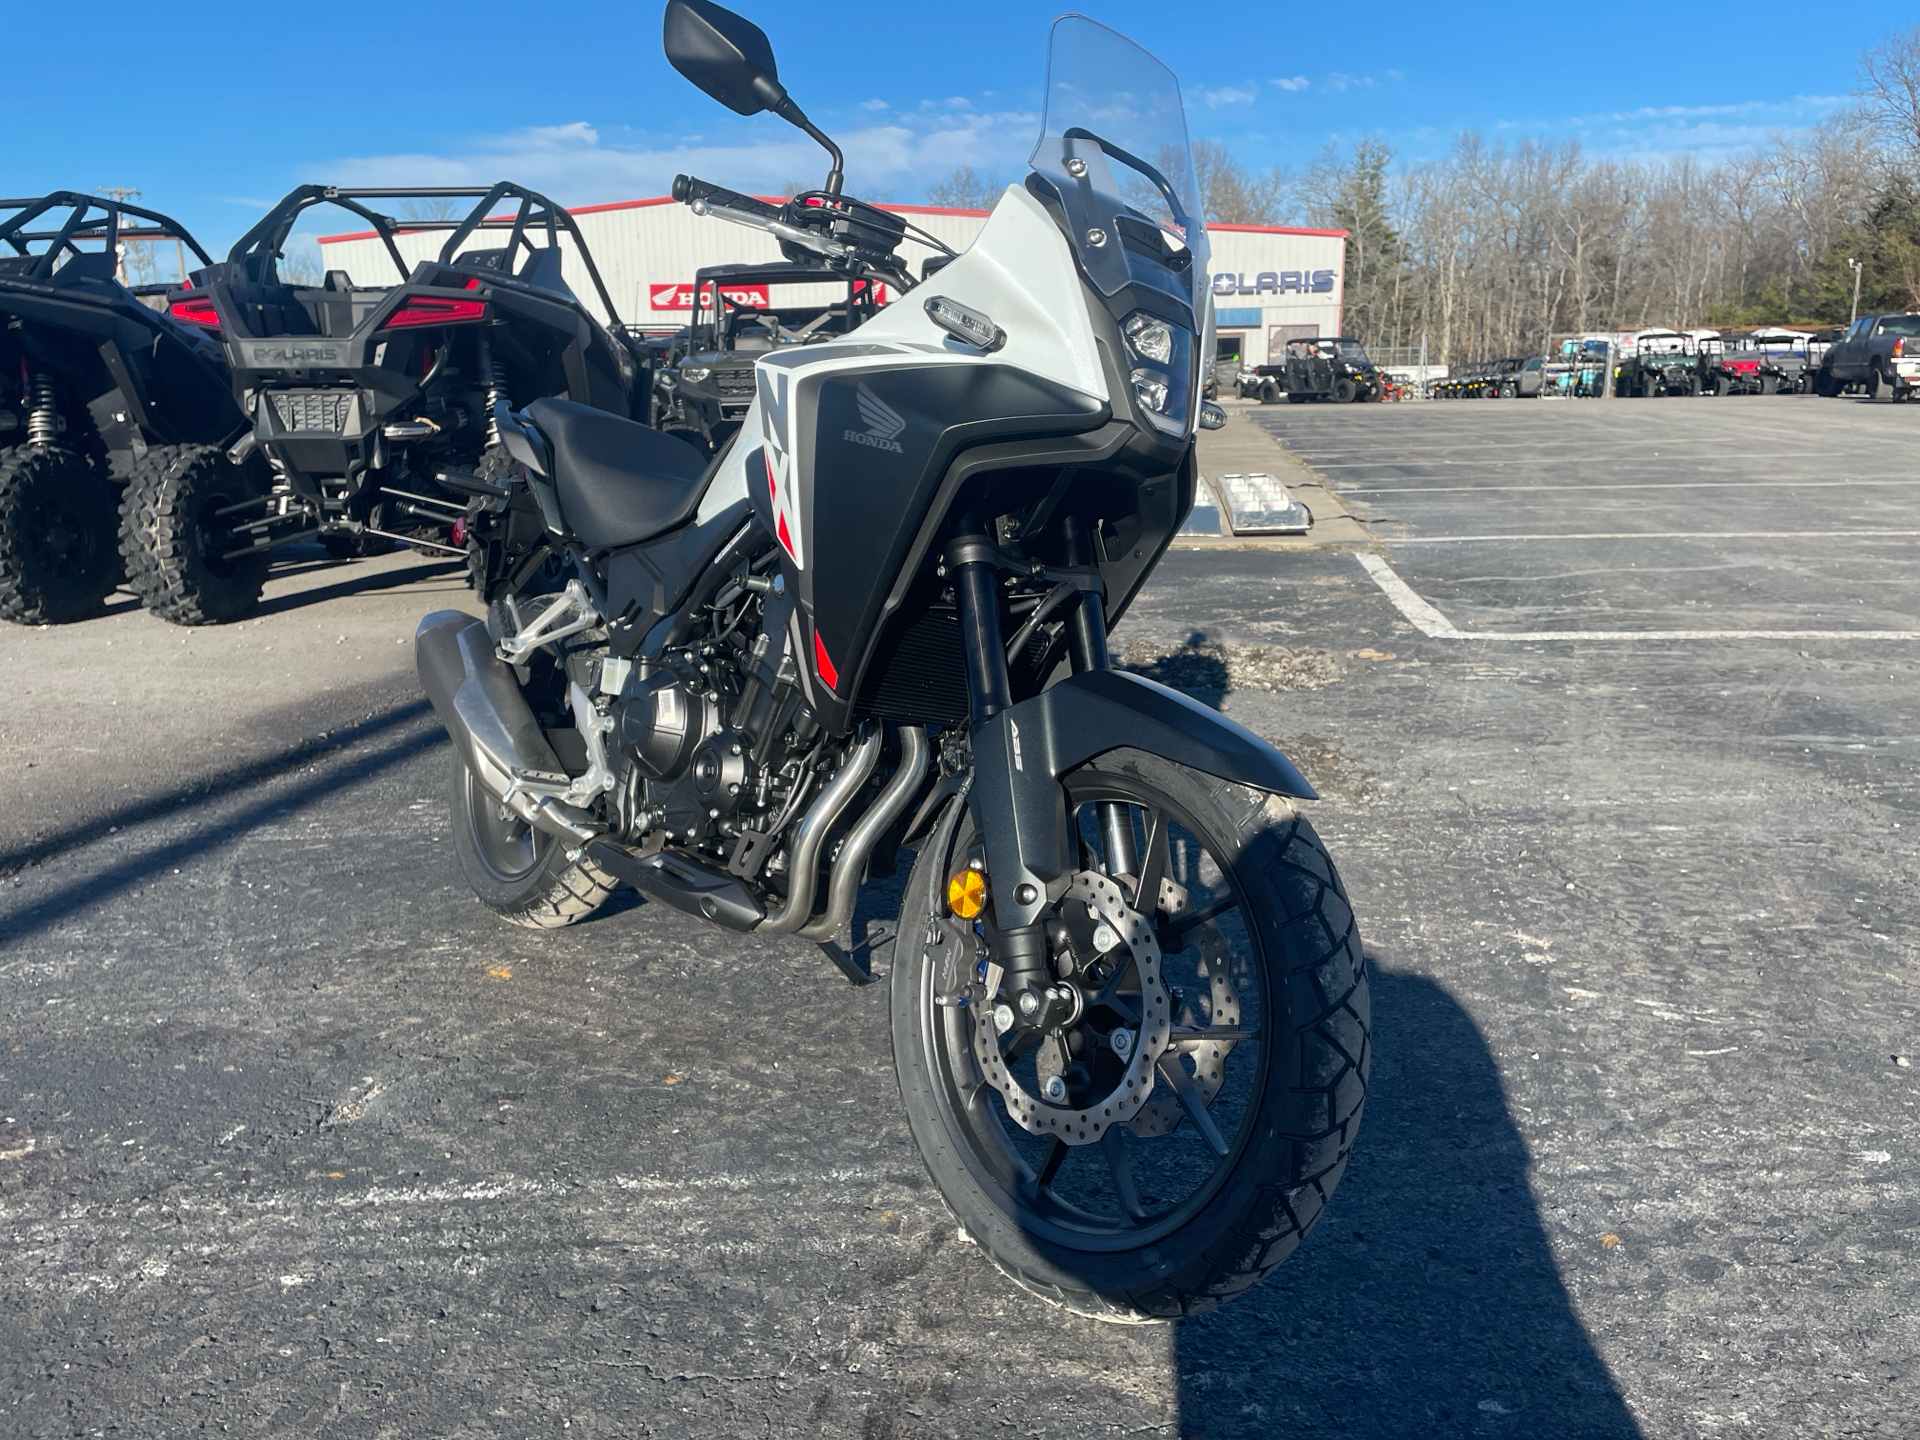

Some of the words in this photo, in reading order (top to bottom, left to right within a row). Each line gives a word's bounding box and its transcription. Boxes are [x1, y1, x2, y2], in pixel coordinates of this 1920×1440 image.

[1212, 269, 1334, 296] OLARIS
[677, 291, 767, 306] HODA
[253, 348, 338, 360] POLARIS
[843, 429, 904, 454] HONDA
[1010, 718, 1023, 773] ABS
